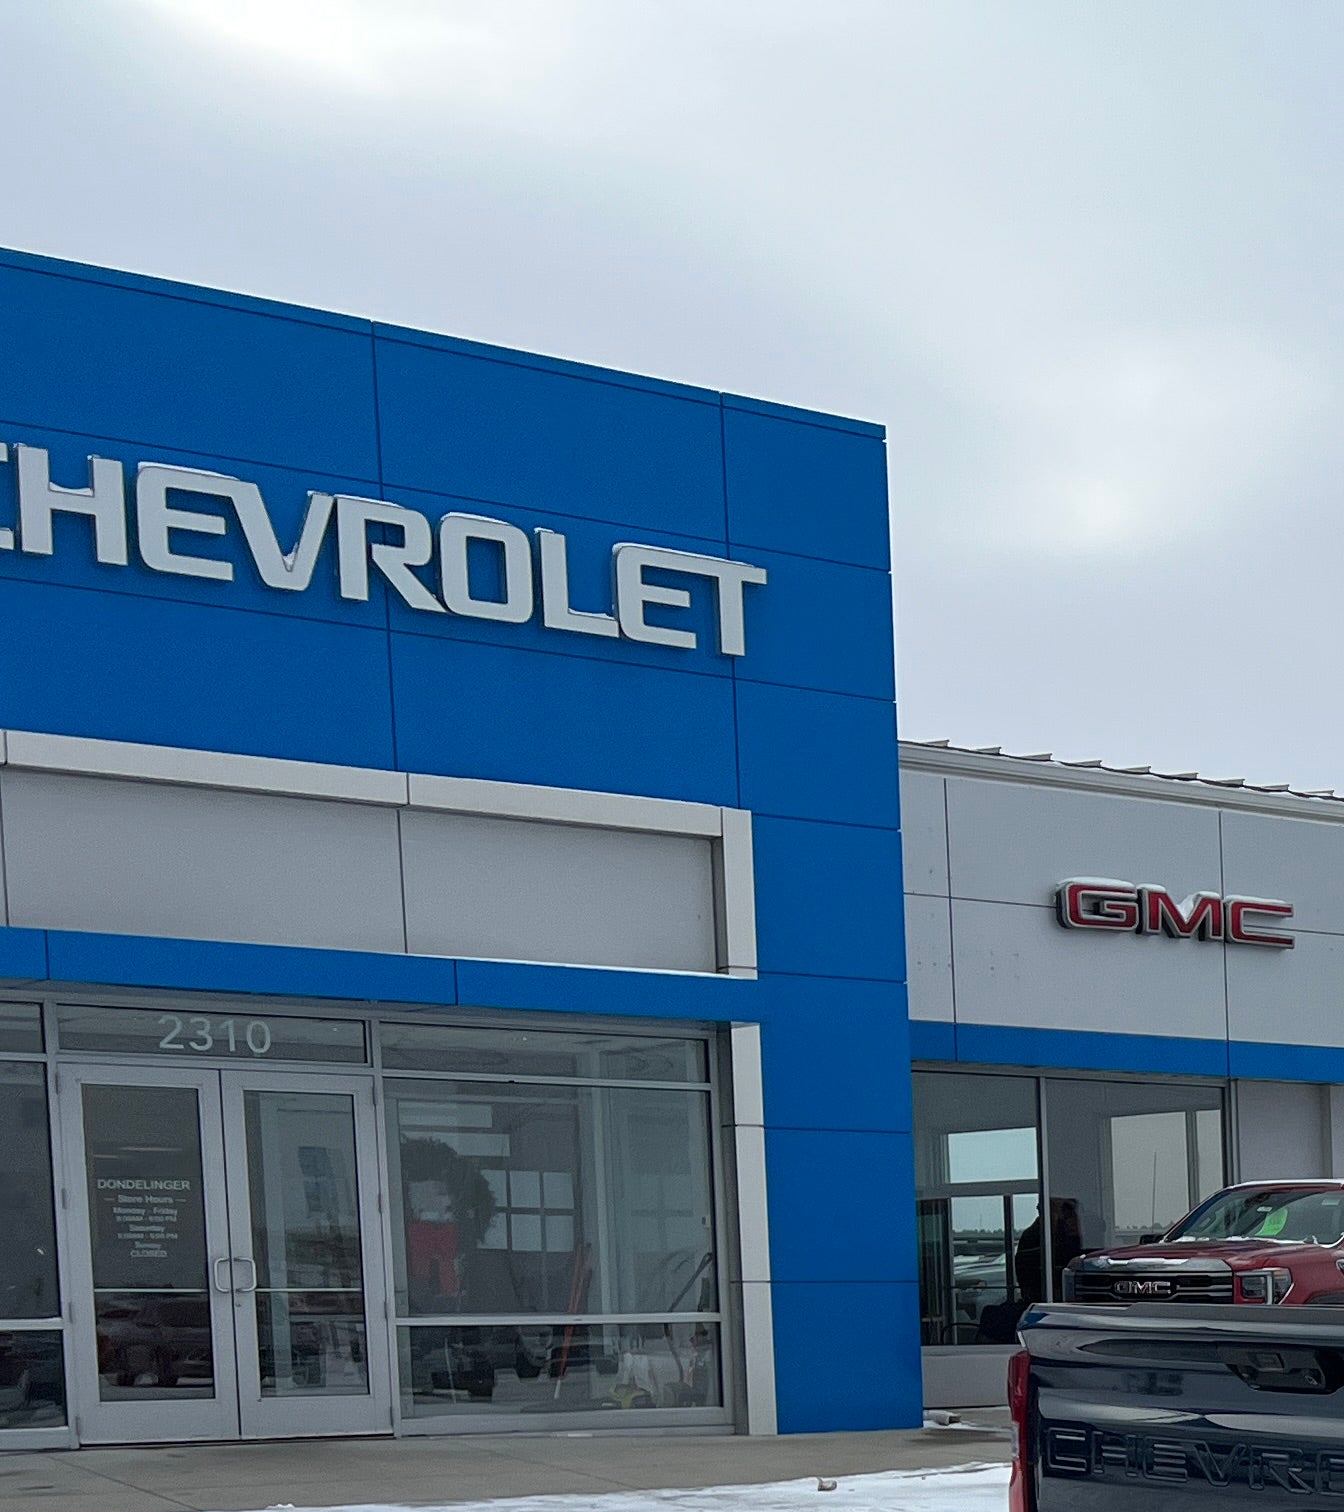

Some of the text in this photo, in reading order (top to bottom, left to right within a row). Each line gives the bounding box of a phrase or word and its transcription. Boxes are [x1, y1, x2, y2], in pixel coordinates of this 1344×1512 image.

[0, 442, 767, 657] HEVROLET
[1055, 876, 1296, 950] GMC
[158, 1014, 271, 1053] 2310
[97, 1179, 191, 1190] DONDELINGER
[1114, 1281, 1171, 1294] GMC
